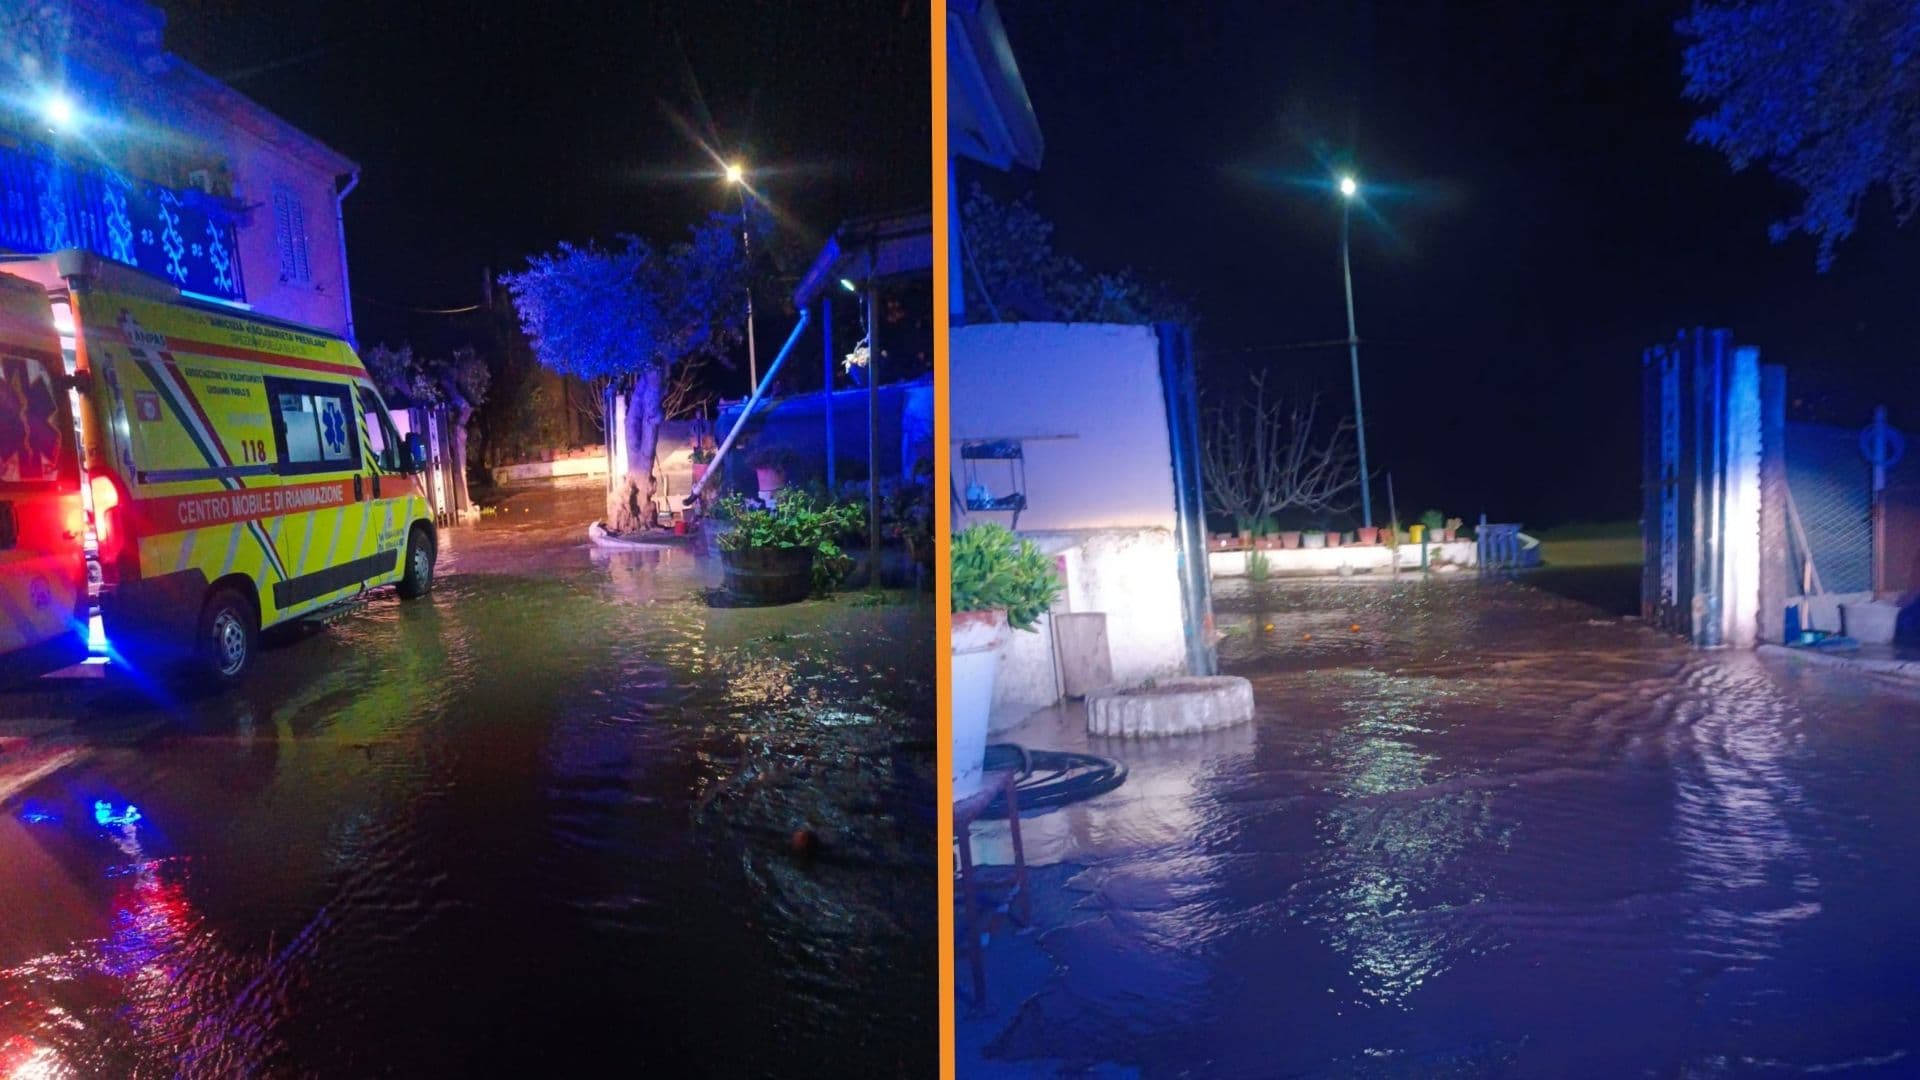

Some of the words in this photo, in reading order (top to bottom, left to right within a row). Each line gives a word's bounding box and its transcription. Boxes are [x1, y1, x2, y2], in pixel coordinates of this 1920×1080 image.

[241, 439, 266, 462] 118
[178, 497, 230, 524] CENTRO
[232, 492, 271, 516] MOBILE
[273, 490, 283, 511] DI
[285, 484, 344, 508] RIANIMAZIONE
